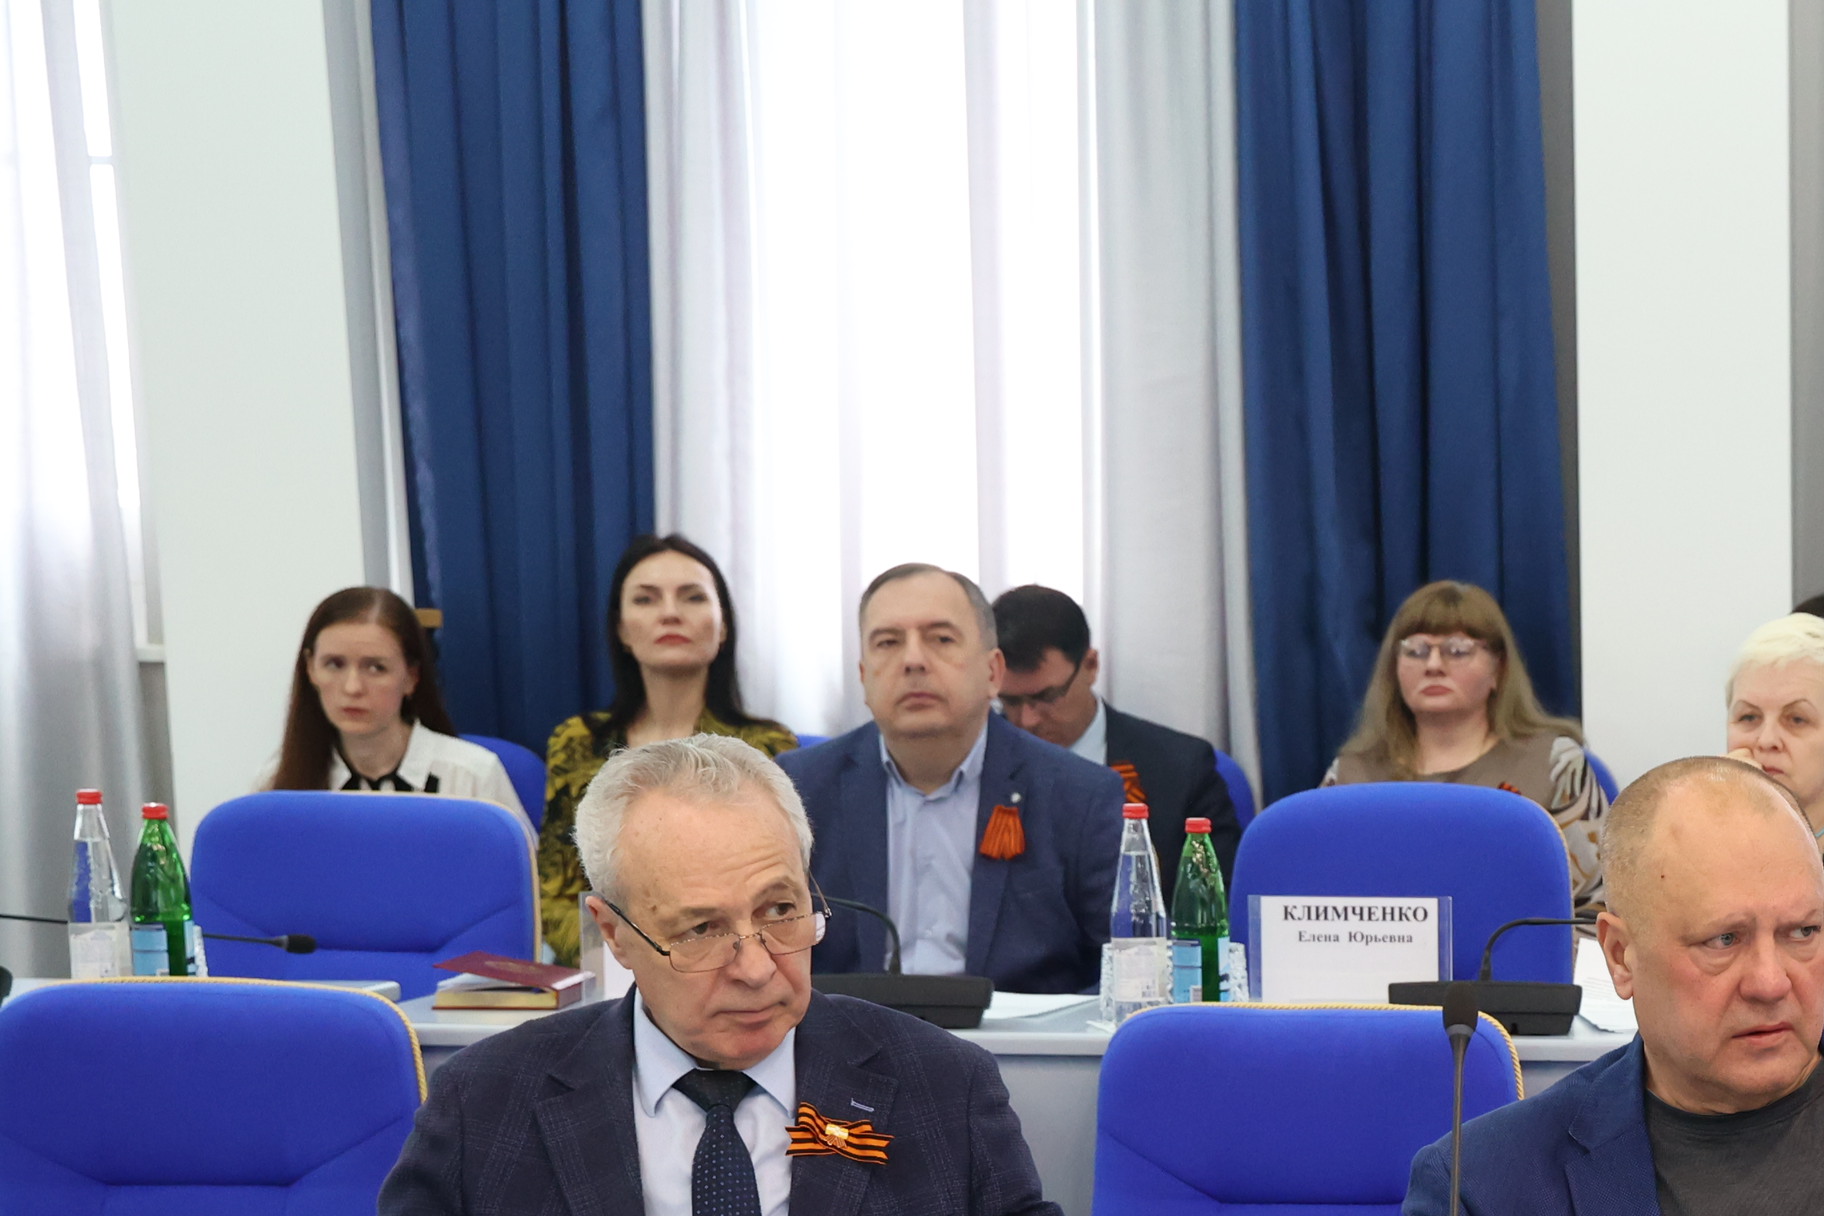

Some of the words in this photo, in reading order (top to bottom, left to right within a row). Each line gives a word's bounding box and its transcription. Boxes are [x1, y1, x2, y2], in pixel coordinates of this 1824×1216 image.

[1282, 904, 1429, 923] КЛИМЧЕНКО
[1298, 930, 1340, 943] Елена
[1348, 930, 1414, 947] Юрьевна
